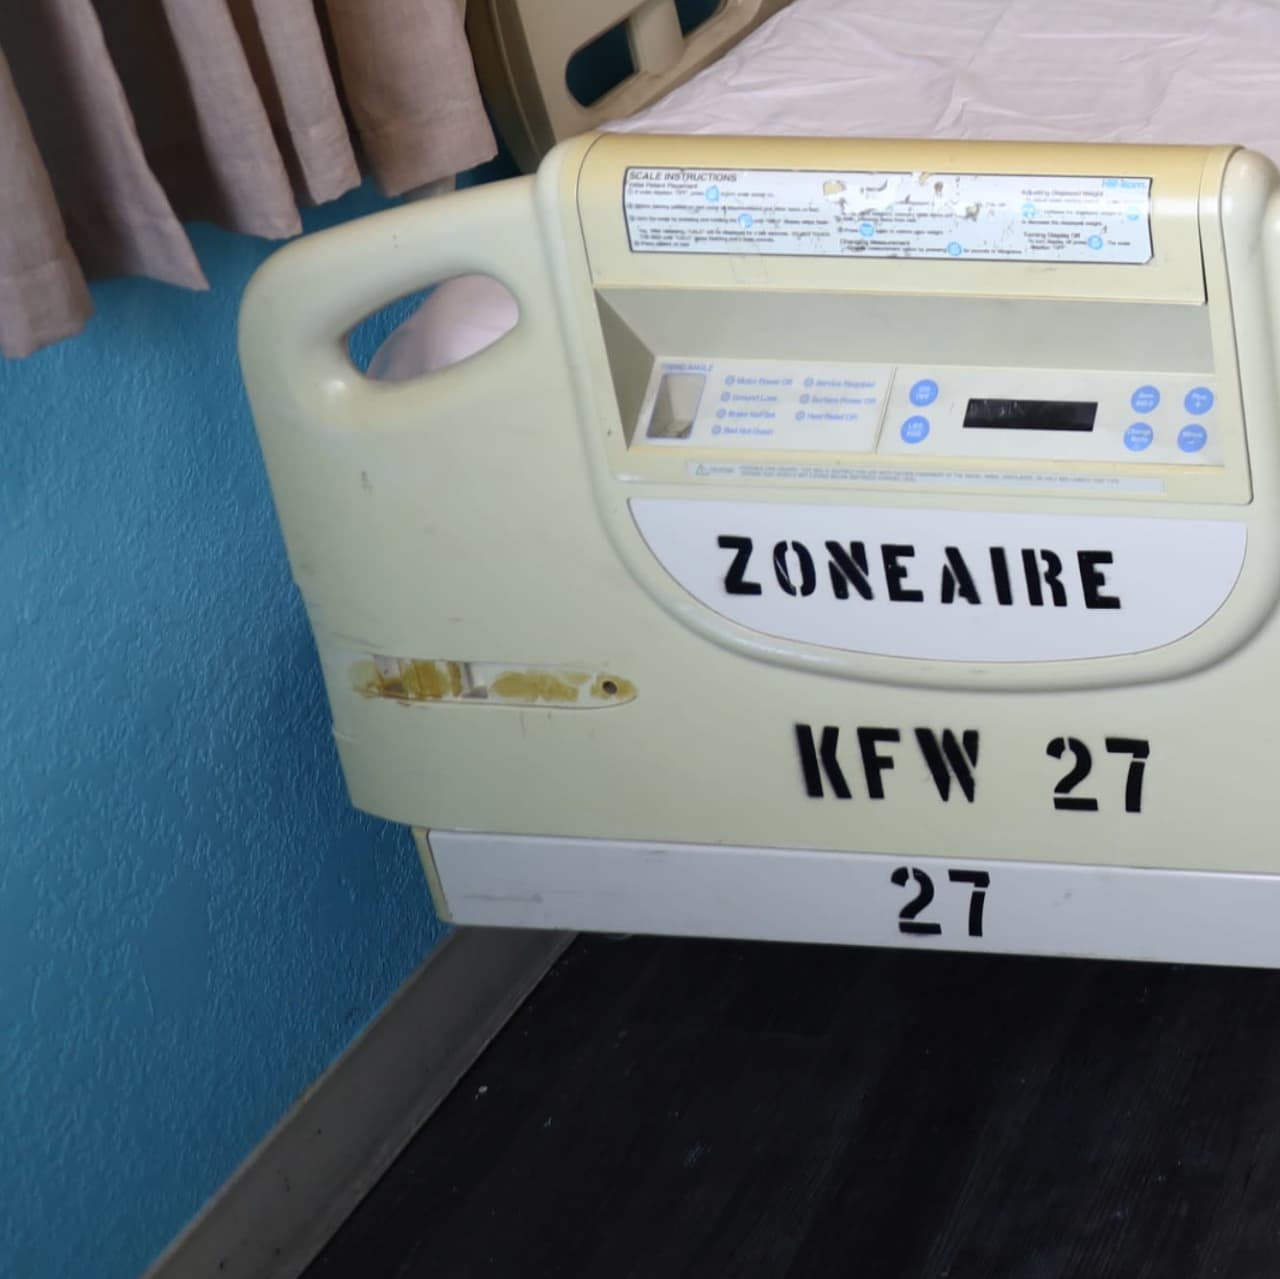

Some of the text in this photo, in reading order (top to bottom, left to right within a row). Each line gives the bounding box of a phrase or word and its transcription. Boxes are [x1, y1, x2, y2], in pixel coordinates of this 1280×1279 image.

[629, 172, 738, 183] SCALE INSTRUCTIONS
[717, 535, 1122, 609] ZONEAIRE
[794, 723, 1150, 813] KFW 27
[890, 866, 990, 937] 27
